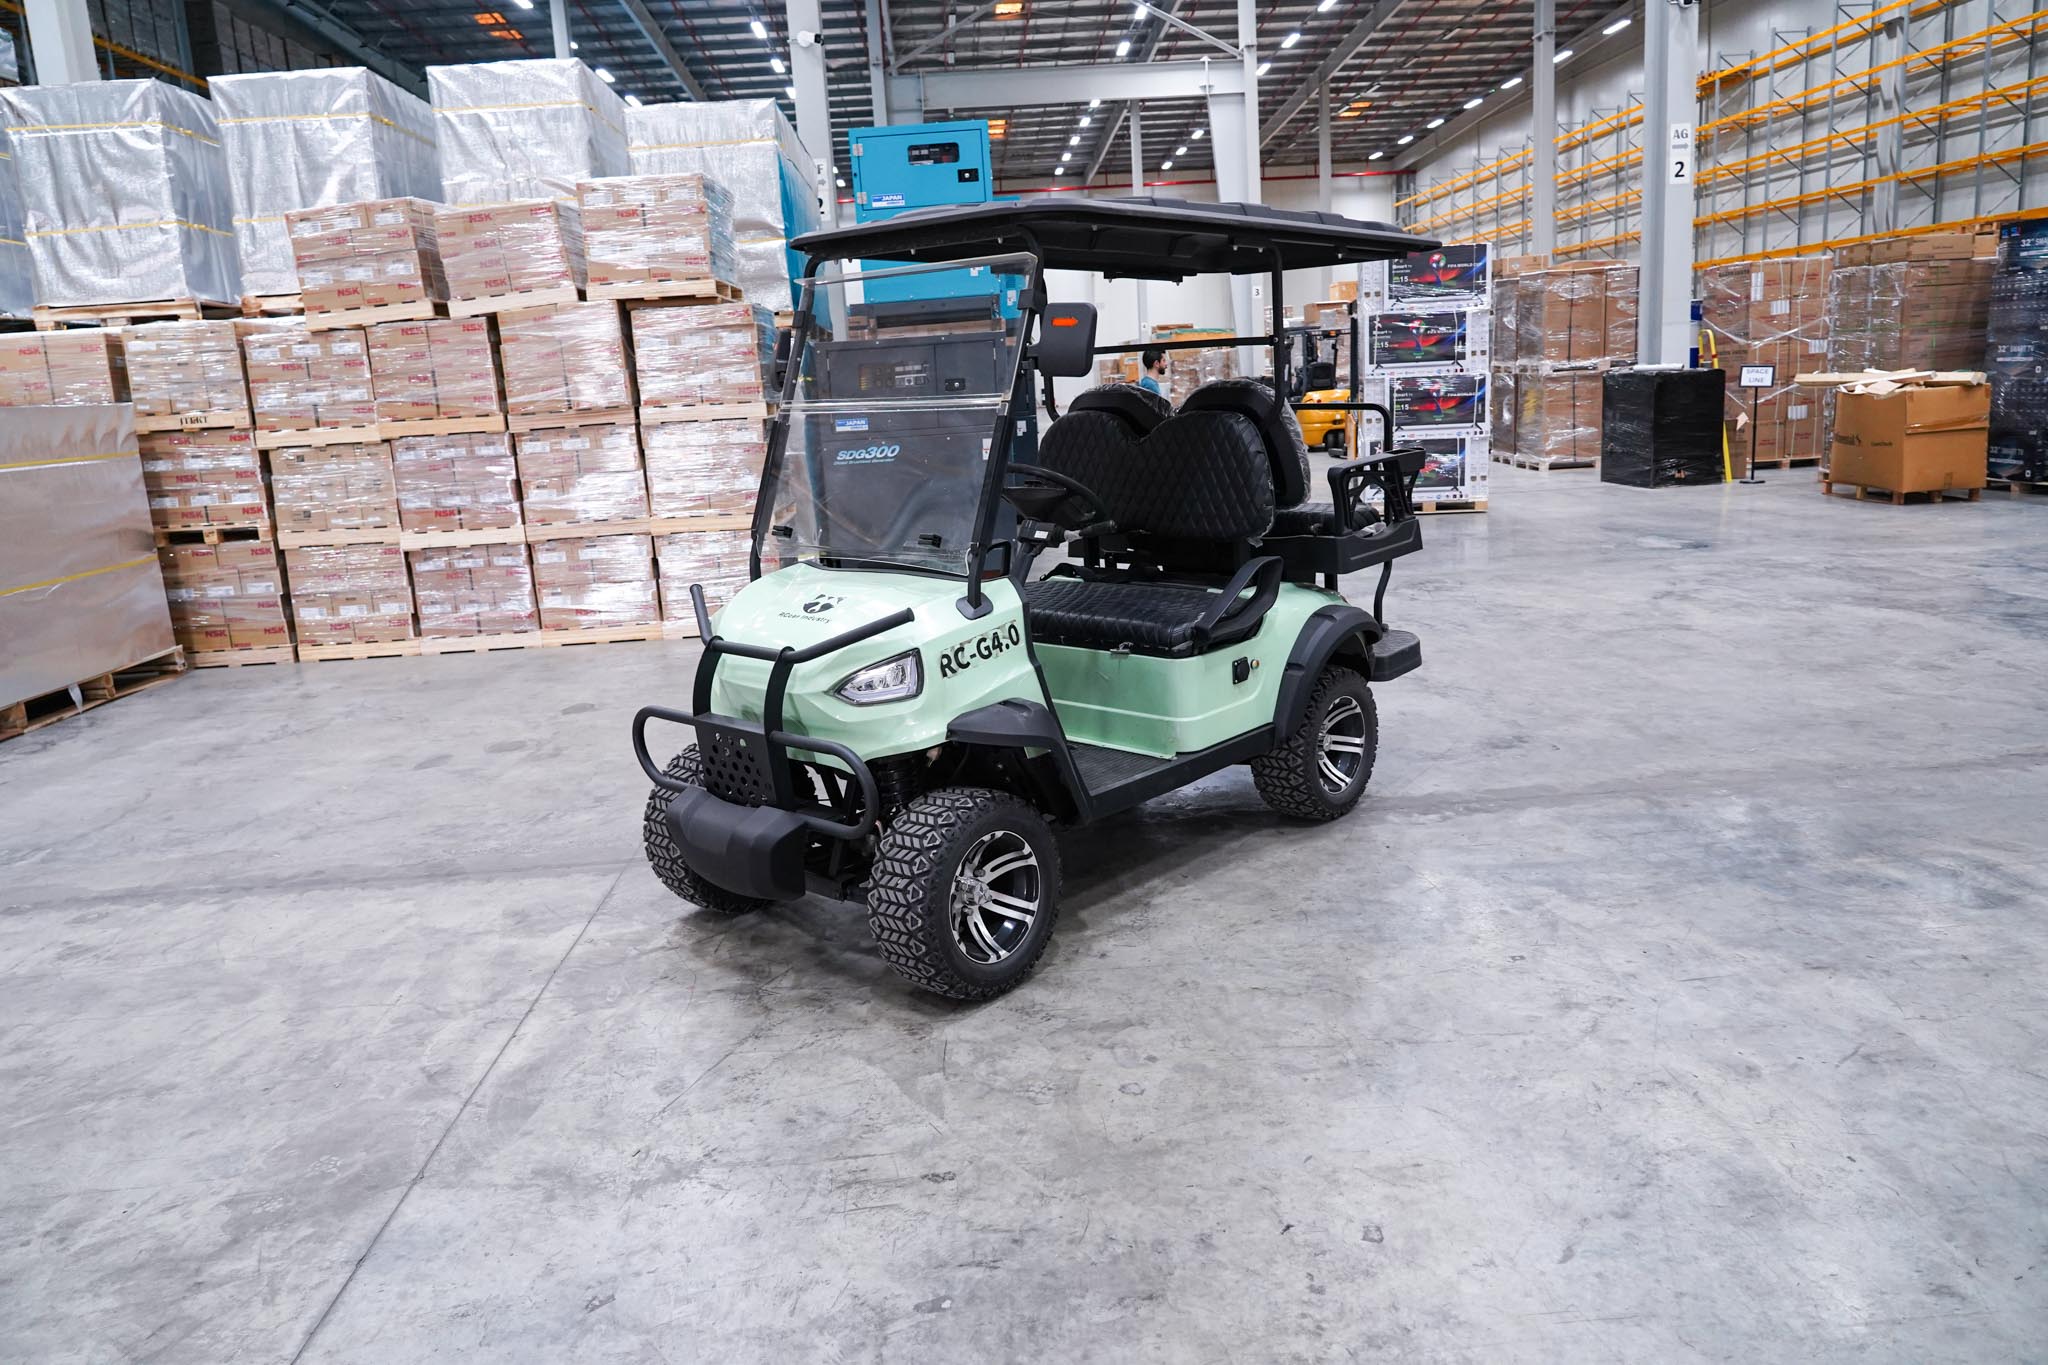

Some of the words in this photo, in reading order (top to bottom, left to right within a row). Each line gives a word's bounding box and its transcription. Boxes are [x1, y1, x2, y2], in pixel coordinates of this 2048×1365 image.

[1673, 129, 1688, 139] AG
[1674, 161, 1685, 178] 2
[616, 208, 639, 219] NSK
[468, 213, 493, 224] NSK
[484, 279, 508, 289] NSK
[336, 287, 361, 297] NSK
[1255, 288, 1260, 297] 3
[228, 434, 251, 442] NSK
[836, 444, 901, 461] SDG300
[175, 474, 198, 483] NSK
[235, 471, 257, 479] NSK
[181, 510, 204, 519] NSK
[242, 506, 265, 515] NSK
[435, 509, 457, 518] NSK
[250, 547, 272, 556] NSK
[205, 629, 228, 638] NSK
[264, 626, 286, 635] NSK
[940, 623, 1020, 678] RC-G4.0
